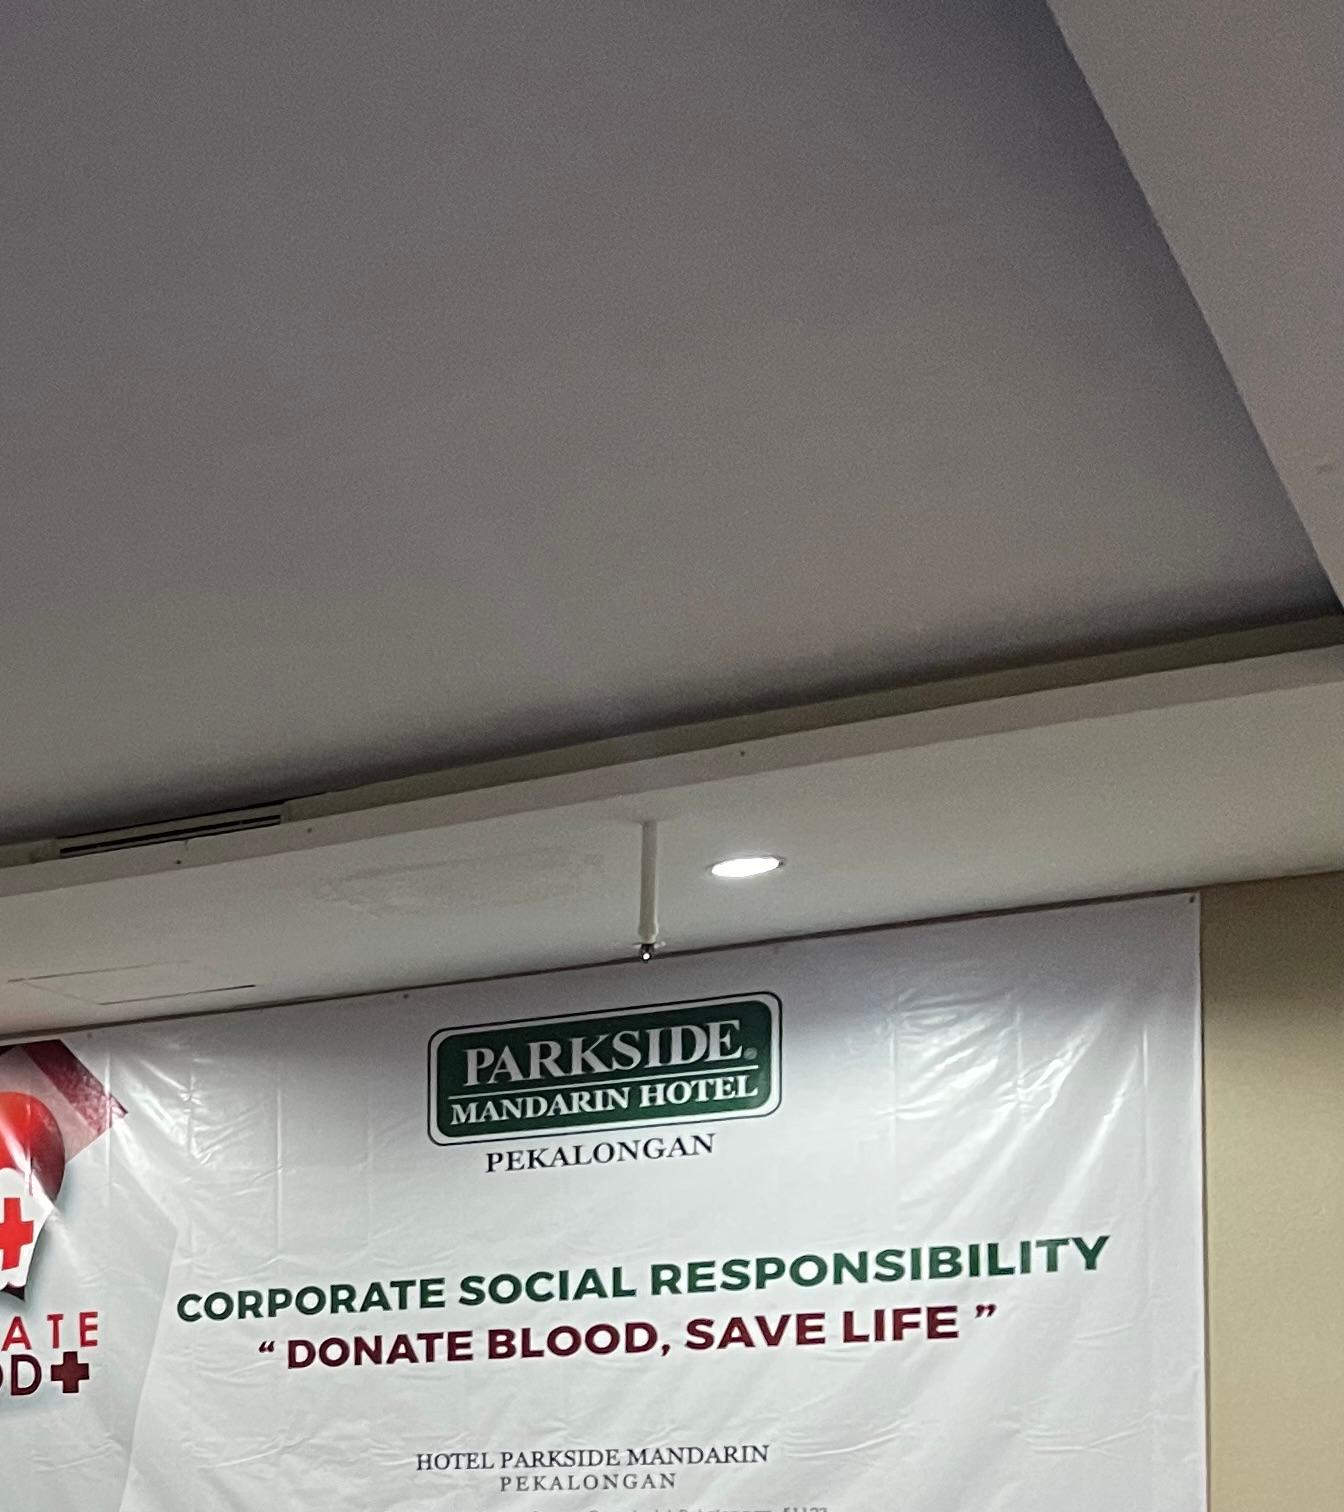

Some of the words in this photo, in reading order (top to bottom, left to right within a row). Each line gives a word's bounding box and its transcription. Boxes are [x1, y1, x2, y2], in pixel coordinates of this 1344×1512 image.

[463, 1019, 743, 1087] PARKSIDE
[450, 1087, 629, 1125] MANDARIN
[639, 1074, 759, 1108] HOTEL
[486, 1132, 716, 1173] PEKALONGAN
[176, 1277, 446, 1322] CORPORATE
[458, 1266, 638, 1306] SOCIAL
[650, 1235, 1111, 1296] RESPONSIBILITY
[287, 1330, 474, 1369] DONATE
[487, 1321, 672, 1360] BLOOD,
[684, 1312, 826, 1351] SAVE
[842, 1305, 960, 1344] LIFE
[416, 1451, 495, 1471] HOTEL
[501, 1449, 620, 1470] PARKSIDE
[626, 1445, 770, 1466] MANDARIN
[500, 1472, 676, 1492] PEKALONGAN
